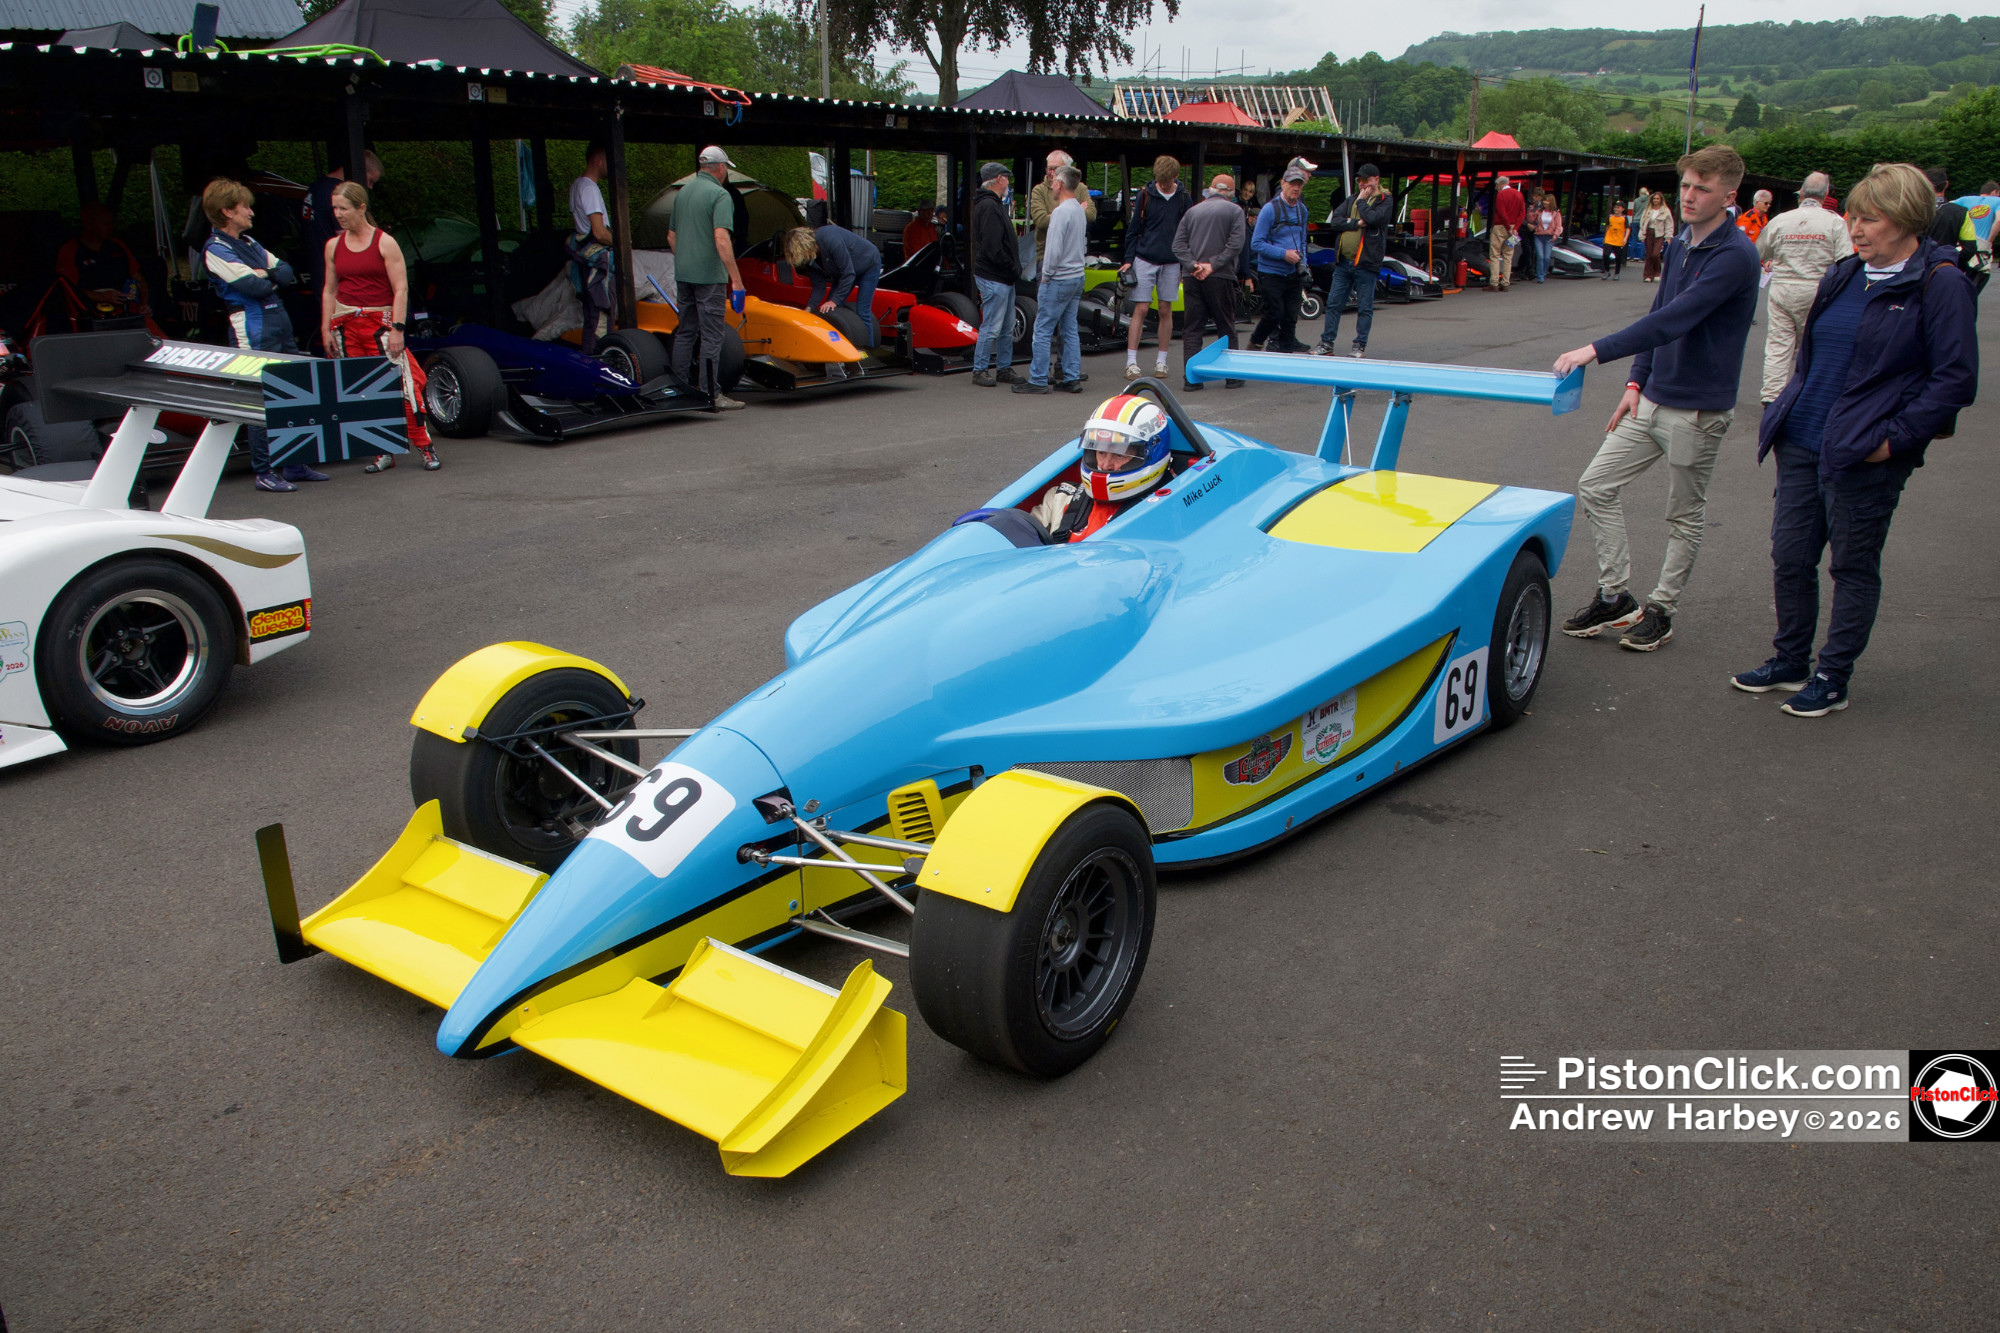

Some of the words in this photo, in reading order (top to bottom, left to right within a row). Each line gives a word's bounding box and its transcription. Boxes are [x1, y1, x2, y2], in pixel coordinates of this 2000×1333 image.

[144, 345, 236, 371] BICKLEY
[1183, 489, 1204, 507] Mike
[1202, 473, 1223, 493] Luck
[251, 606, 303, 627] demon
[251, 616, 305, 639] tweeks
[6, 662, 24, 671] 2026
[1445, 659, 1479, 730] 69
[103, 714, 179, 733] AVON
[595, 768, 702, 842] 69
